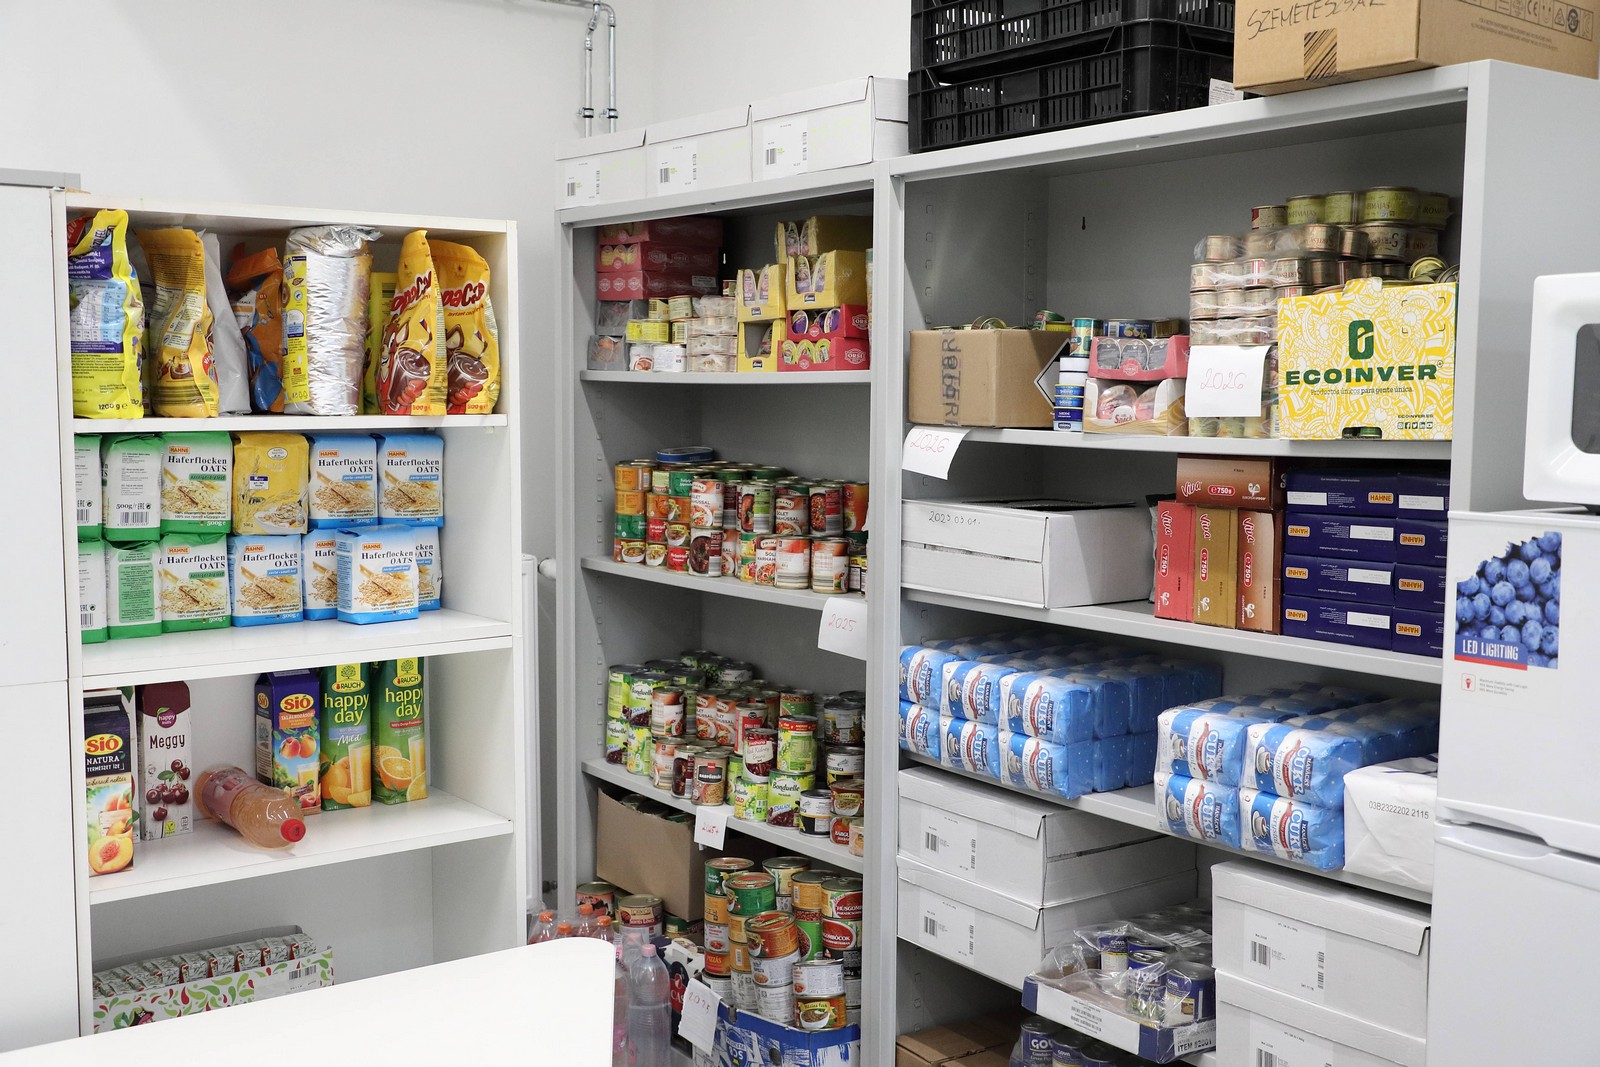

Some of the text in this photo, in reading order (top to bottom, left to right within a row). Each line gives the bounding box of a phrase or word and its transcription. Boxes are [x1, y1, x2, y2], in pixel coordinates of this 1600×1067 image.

[1201, 369, 1248, 390] 2026
[1286, 364, 1438, 385] ECOINVER
[910, 429, 949, 453] 2026
[168, 456, 227, 464] Haferflocken
[318, 458, 373, 466] Haferflocken
[387, 458, 440, 466] Haferflocken
[1181, 481, 1202, 497] Viva
[1370, 494, 1392, 502] HAHNE
[1161, 511, 1173, 537] Viva
[1200, 513, 1211, 540] Viva
[1243, 517, 1255, 544] Viva
[1289, 527, 1309, 535] HAHNE
[1400, 535, 1424, 545] HAHNE
[167, 555, 226, 564] Haferflocken
[243, 553, 298, 561] Haferflocken
[361, 550, 414, 560] Haferflocken
[200, 562, 226, 570] OATS
[1287, 570, 1307, 578] HAHNE
[1400, 580, 1423, 590] HAHNE
[828, 613, 856, 632] 2025
[1287, 612, 1307, 620] HAHNE
[1397, 625, 1420, 635] HAHNE
[1462, 639, 1519, 661] LED LIGHTING
[324, 693, 369, 711] happy
[977, 676, 988, 717] CUKR
[159, 714, 175, 722] happy
[334, 708, 364, 726] day
[395, 702, 421, 719] day
[1040, 692, 1050, 735] CUKR
[150, 734, 185, 750] Meggy
[337, 735, 361, 747] Mild
[976, 730, 985, 771] CUKR
[87, 755, 120, 766] NATURA
[1274, 750, 1283, 784] krystal
[1294, 747, 1310, 795] CUKR
[772, 781, 800, 791] Bonduelle
[1200, 793, 1216, 840] CUKR
[1369, 800, 1429, 819] 03B2322202 2115
[1271, 815, 1280, 848] krystal
[1031, 1039, 1052, 1049] GO
